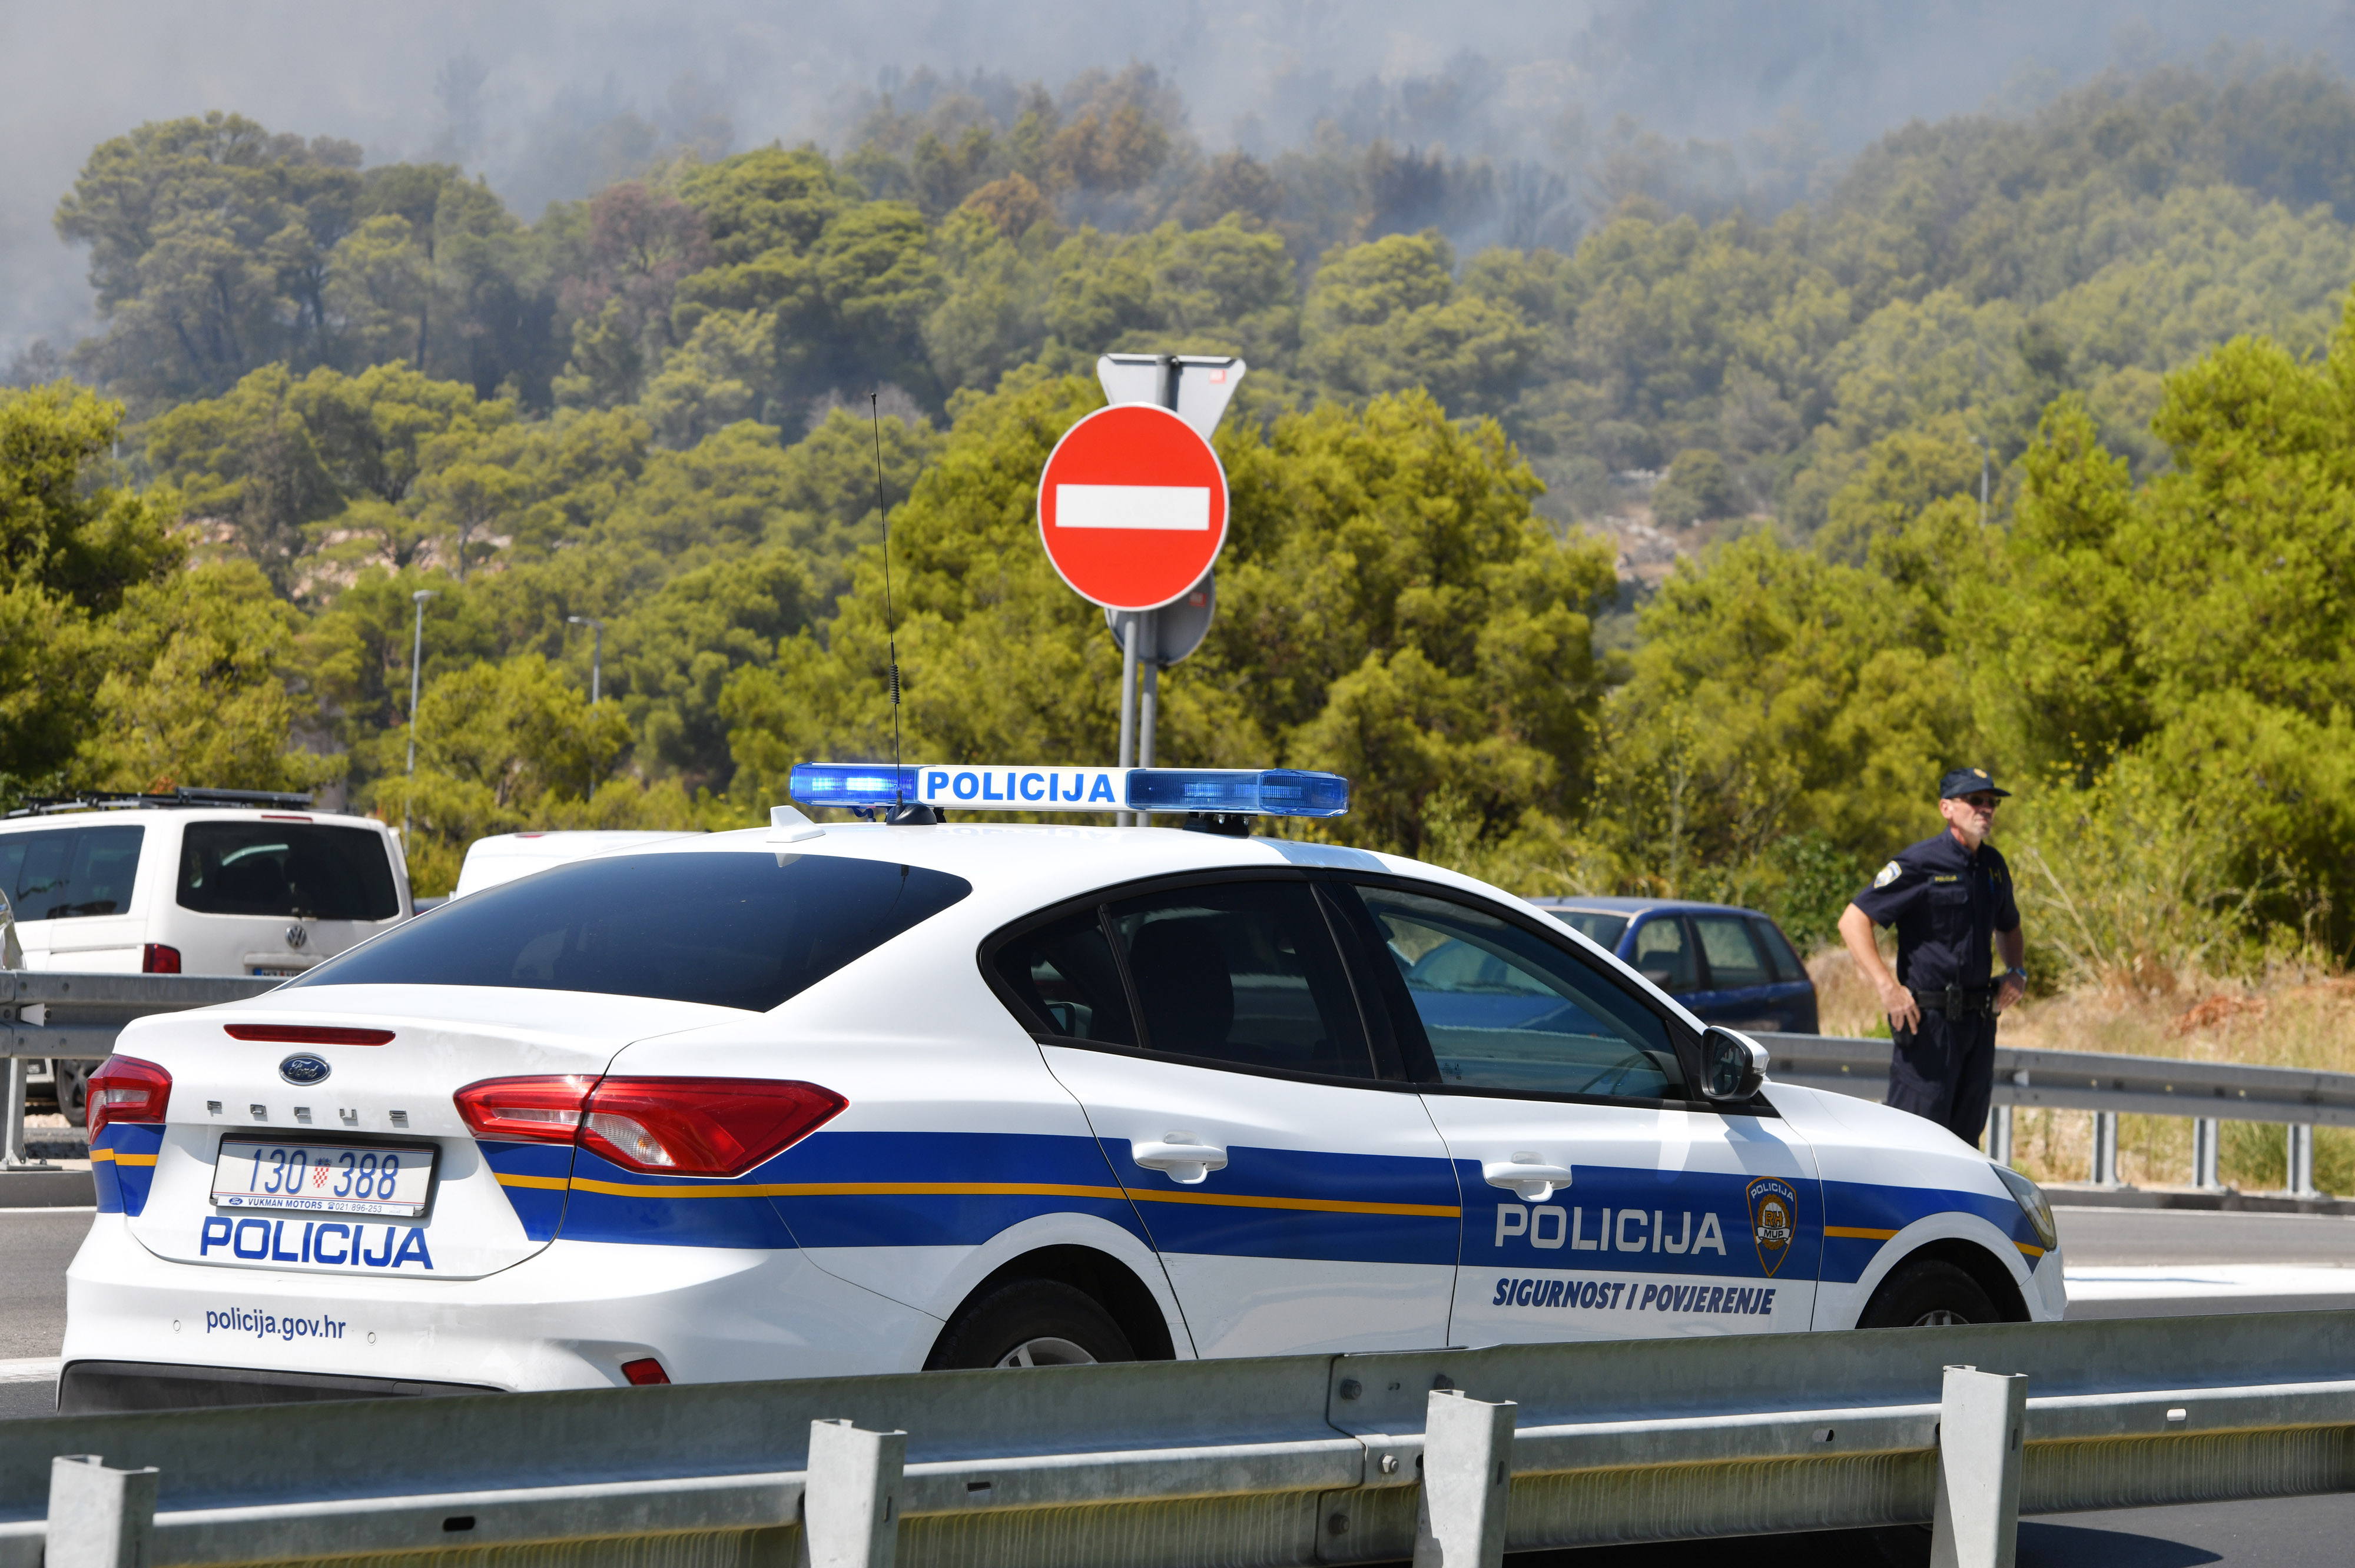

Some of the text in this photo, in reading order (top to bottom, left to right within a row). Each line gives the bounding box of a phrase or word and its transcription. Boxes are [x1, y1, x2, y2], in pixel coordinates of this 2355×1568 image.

[926, 771, 1116, 803] POLICIJA
[288, 1059, 319, 1078] Ford
[207, 1100, 407, 1121] FOCUS
[250, 1148, 400, 1200] 130 388
[248, 1198, 283, 1207] VUKMAN
[286, 1200, 323, 1210] MOTORS
[1750, 1182, 1795, 1202] POLICIJA
[1494, 1203, 1727, 1255] POLICIJA
[1764, 1210, 1783, 1228] RH
[200, 1215, 434, 1270] POLICIJA
[1763, 1229, 1784, 1238] MUP
[1492, 1277, 1776, 1315] SIGURNOST I POVJERENJE
[206, 1307, 346, 1341] policija.gov.hr
